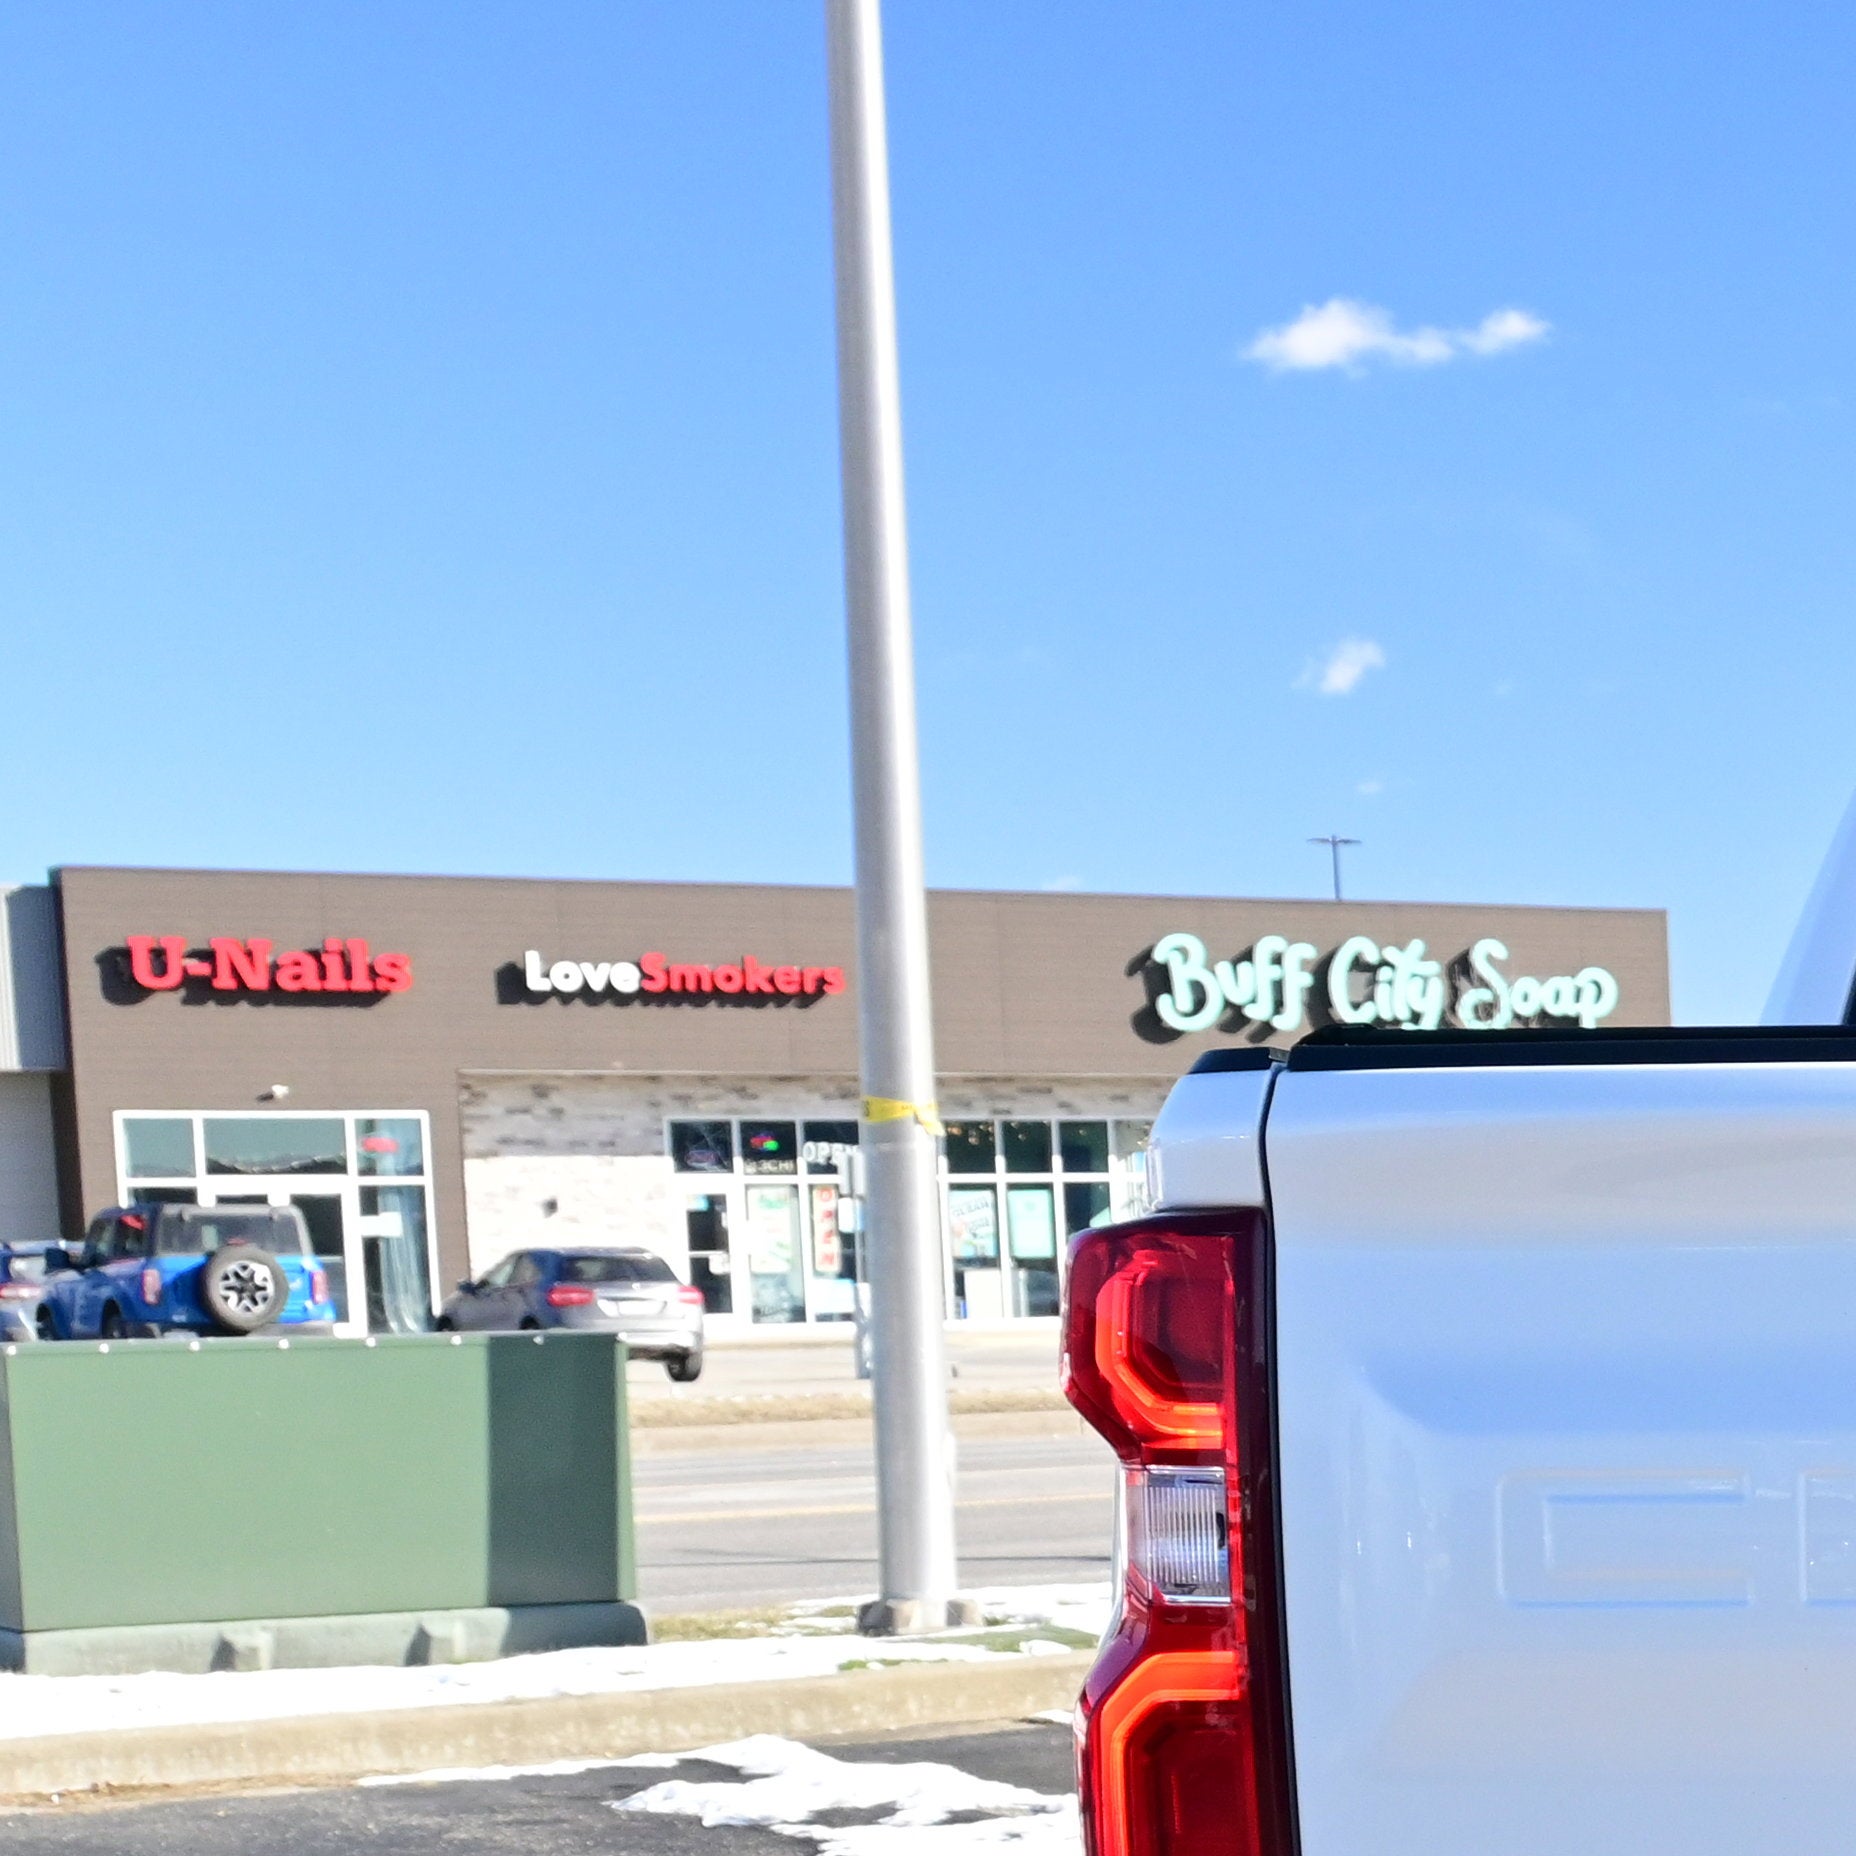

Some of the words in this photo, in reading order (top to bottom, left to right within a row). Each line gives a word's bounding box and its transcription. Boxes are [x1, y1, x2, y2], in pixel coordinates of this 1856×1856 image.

[127, 936, 413, 993] U-Nails
[1152, 933, 1318, 1031] Buff
[1327, 936, 1443, 1029] City
[1458, 938, 1618, 1027] Soap
